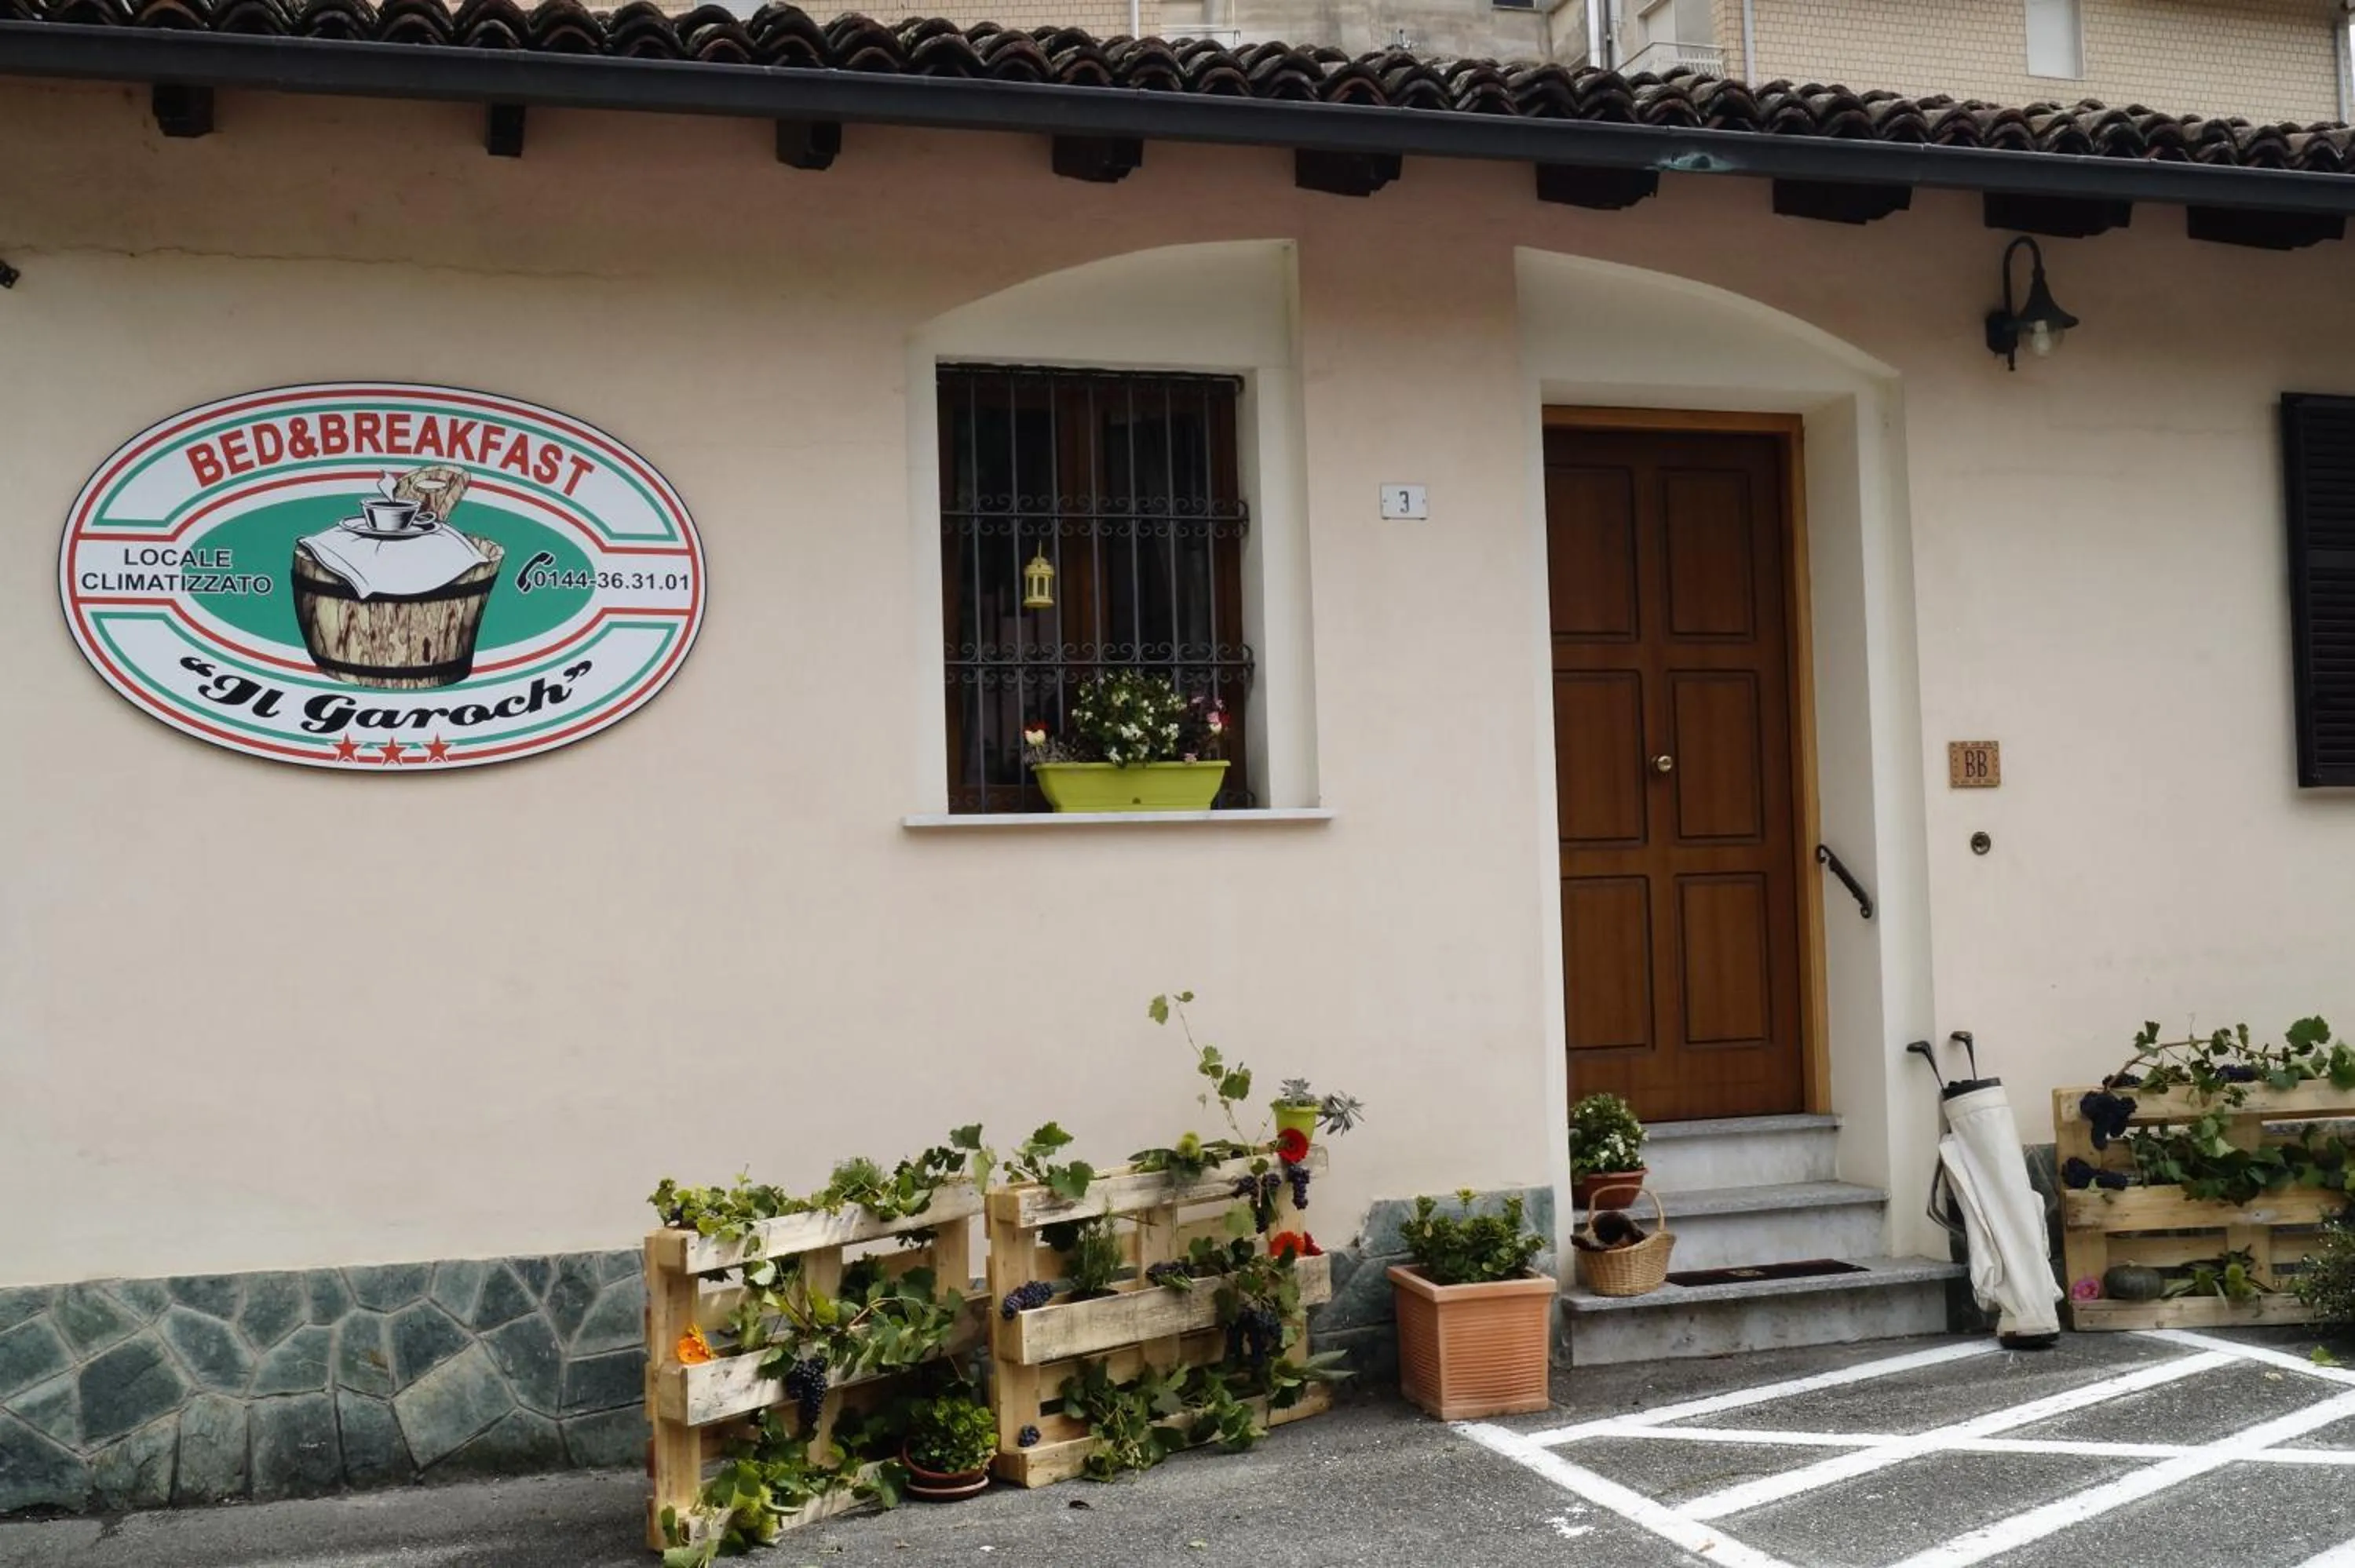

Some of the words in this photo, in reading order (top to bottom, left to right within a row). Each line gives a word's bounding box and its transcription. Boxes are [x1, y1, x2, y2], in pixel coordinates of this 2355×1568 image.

[185, 412, 595, 496] BED&BREAKFAST
[1399, 490, 1409, 512] 3
[124, 549, 231, 567] LOCALE
[81, 572, 272, 593] CLIMATIZZATO
[535, 571, 689, 590] 0144-36.31.01
[1965, 749, 1988, 778] BB
